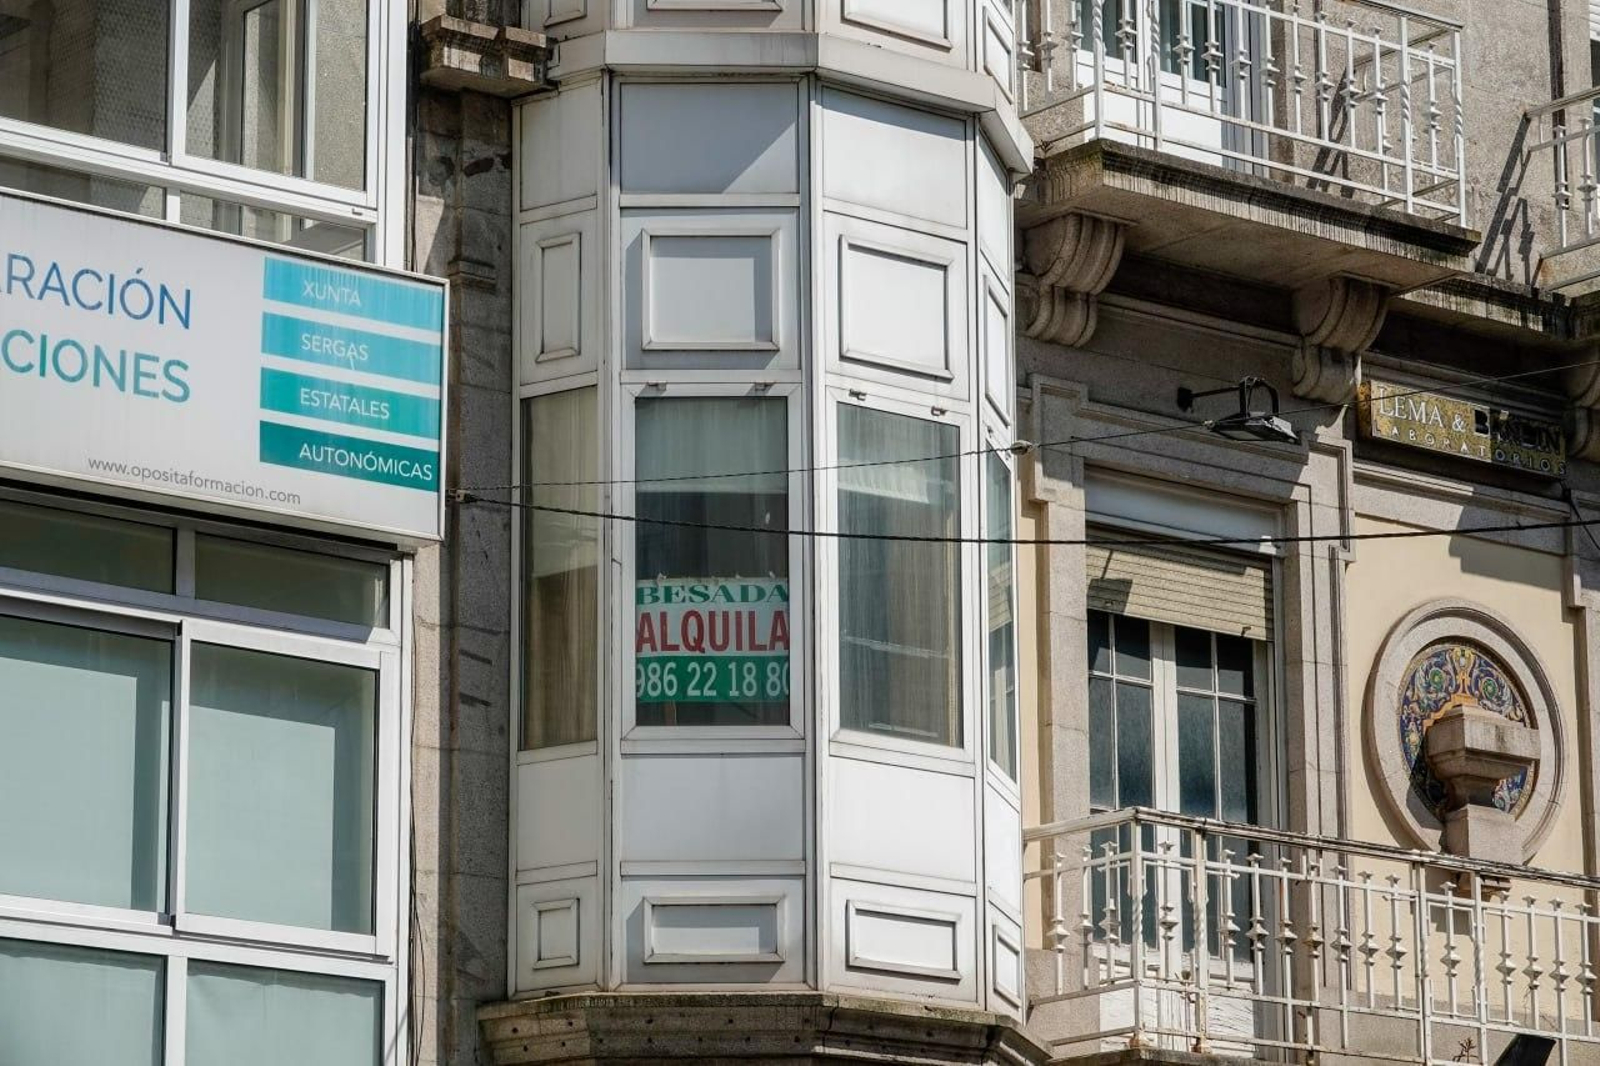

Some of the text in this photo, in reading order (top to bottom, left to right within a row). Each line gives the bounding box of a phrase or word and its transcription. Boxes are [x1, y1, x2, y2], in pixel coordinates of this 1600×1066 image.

[0, 253, 191, 330] RACIÓN
[302, 280, 362, 307] XUNTA
[1, 329, 191, 403] CIONES
[301, 333, 369, 361] SERGAS
[300, 388, 391, 420] ESTATALES
[1378, 385, 1445, 428] LEMA
[1452, 413, 1466, 433] &
[299, 443, 433, 481] AUTONÓMICAS
[1374, 420, 1567, 476] LABORATORIOS
[88, 457, 301, 505] www.opositaformacion.com
[636, 584, 788, 605] BESADA
[636, 610, 788, 653] ALQUILA
[636, 661, 678, 697] 986
[687, 661, 717, 696] 22
[728, 661, 757, 697] 18
